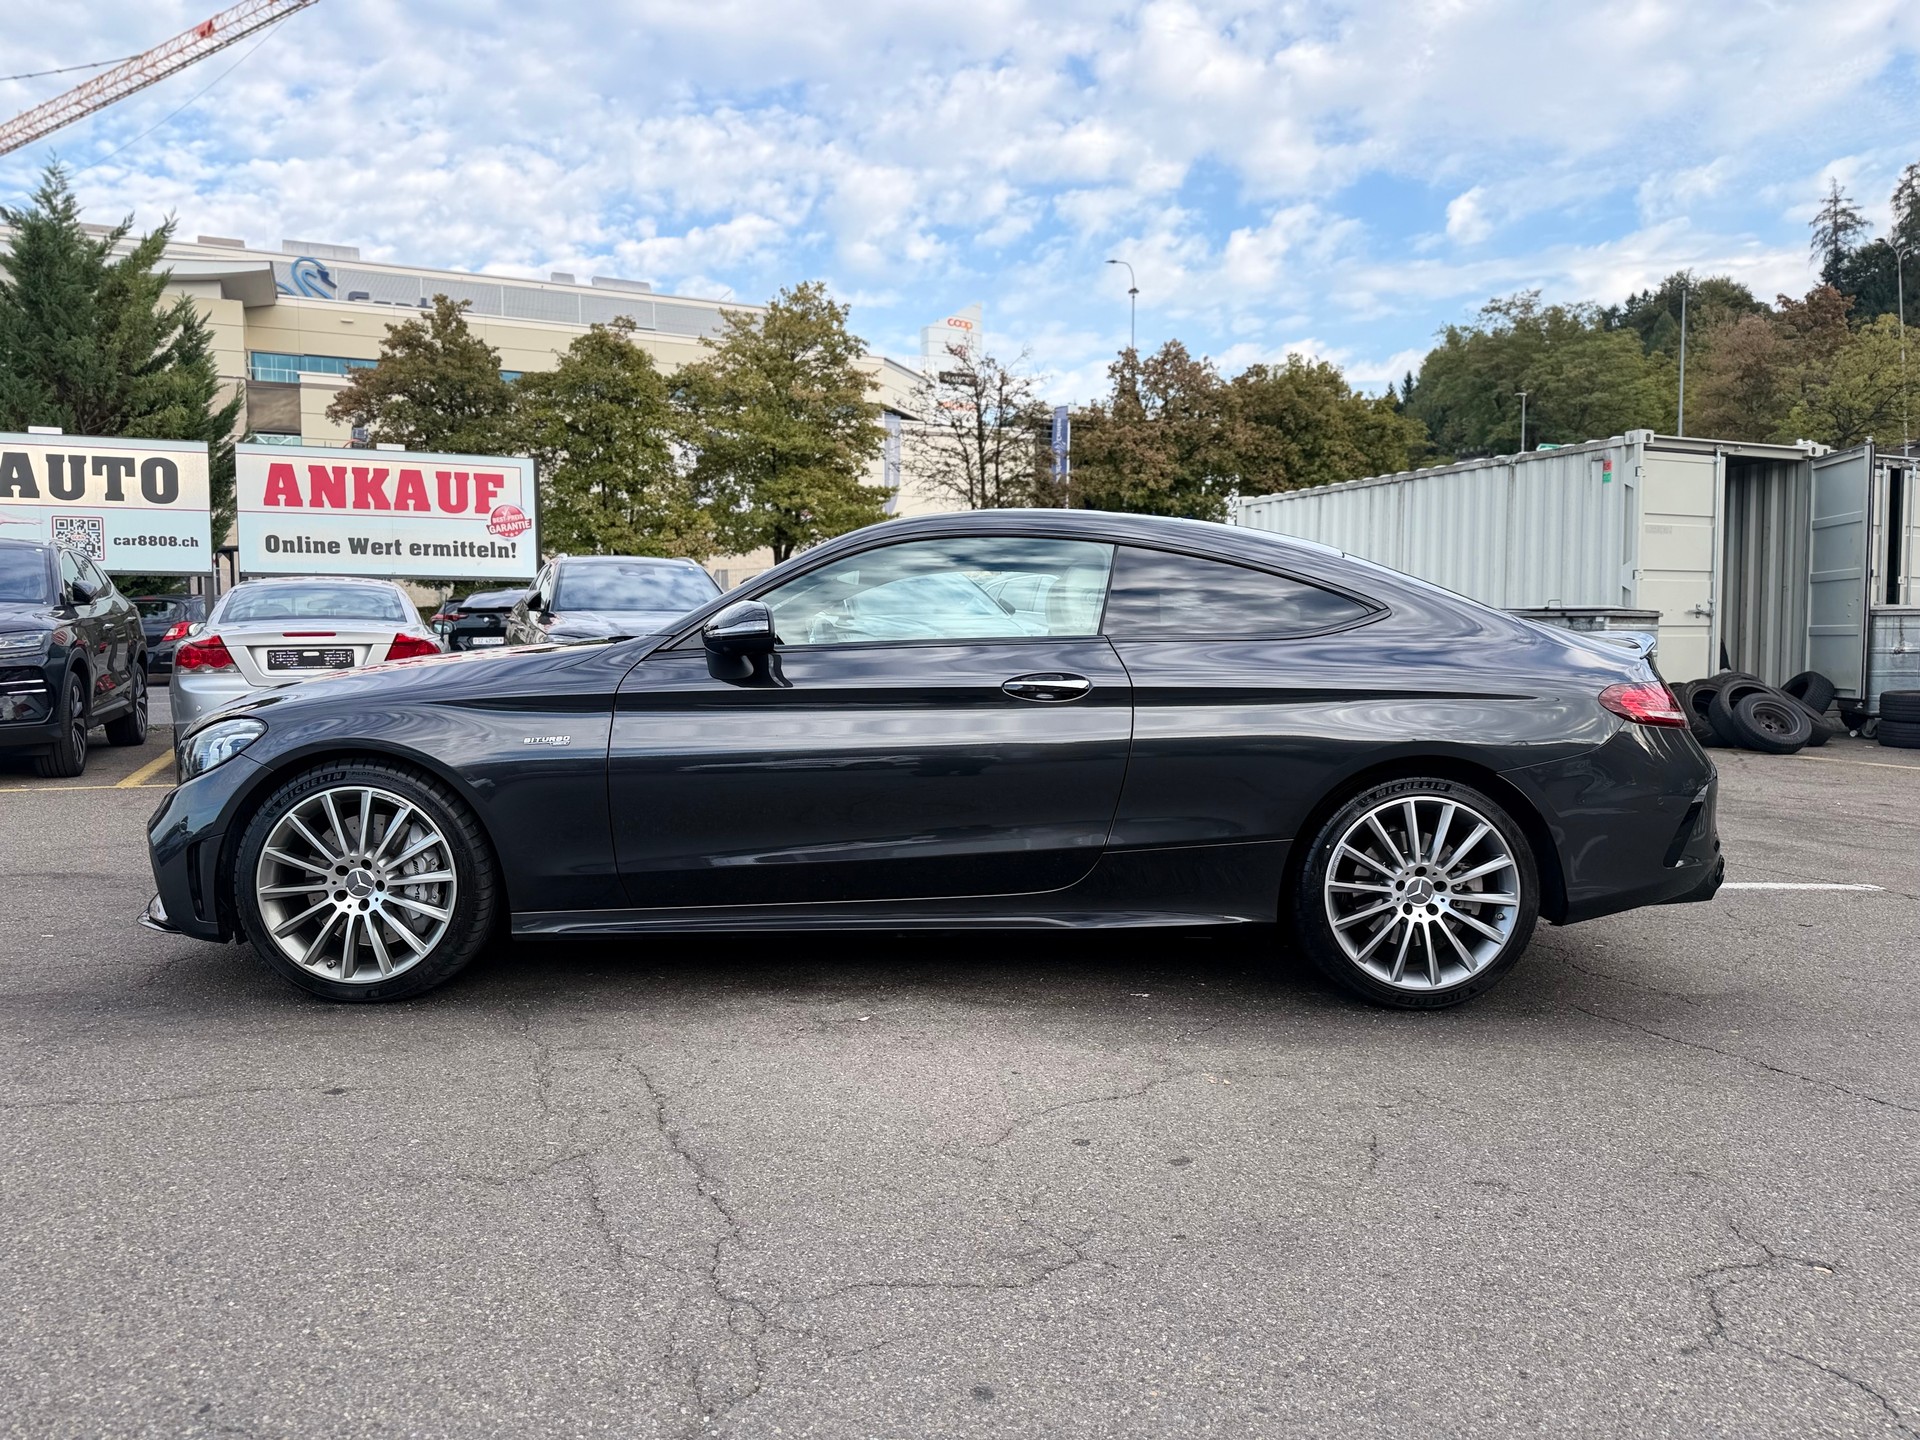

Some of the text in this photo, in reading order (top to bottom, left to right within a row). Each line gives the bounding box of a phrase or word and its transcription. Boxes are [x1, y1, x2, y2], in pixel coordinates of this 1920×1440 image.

[947, 318, 972, 332] coop
[0, 451, 179, 504] AUTO
[263, 462, 504, 514] ANKAUF
[489, 520, 531, 534] GARANTIE
[113, 535, 199, 548] car8808.ch
[265, 534, 517, 559] Online Wert ermitteln!
[523, 735, 571, 745] BITURBO
[279, 771, 343, 806] MICHELIN
[1375, 781, 1447, 799] MICHELIN
